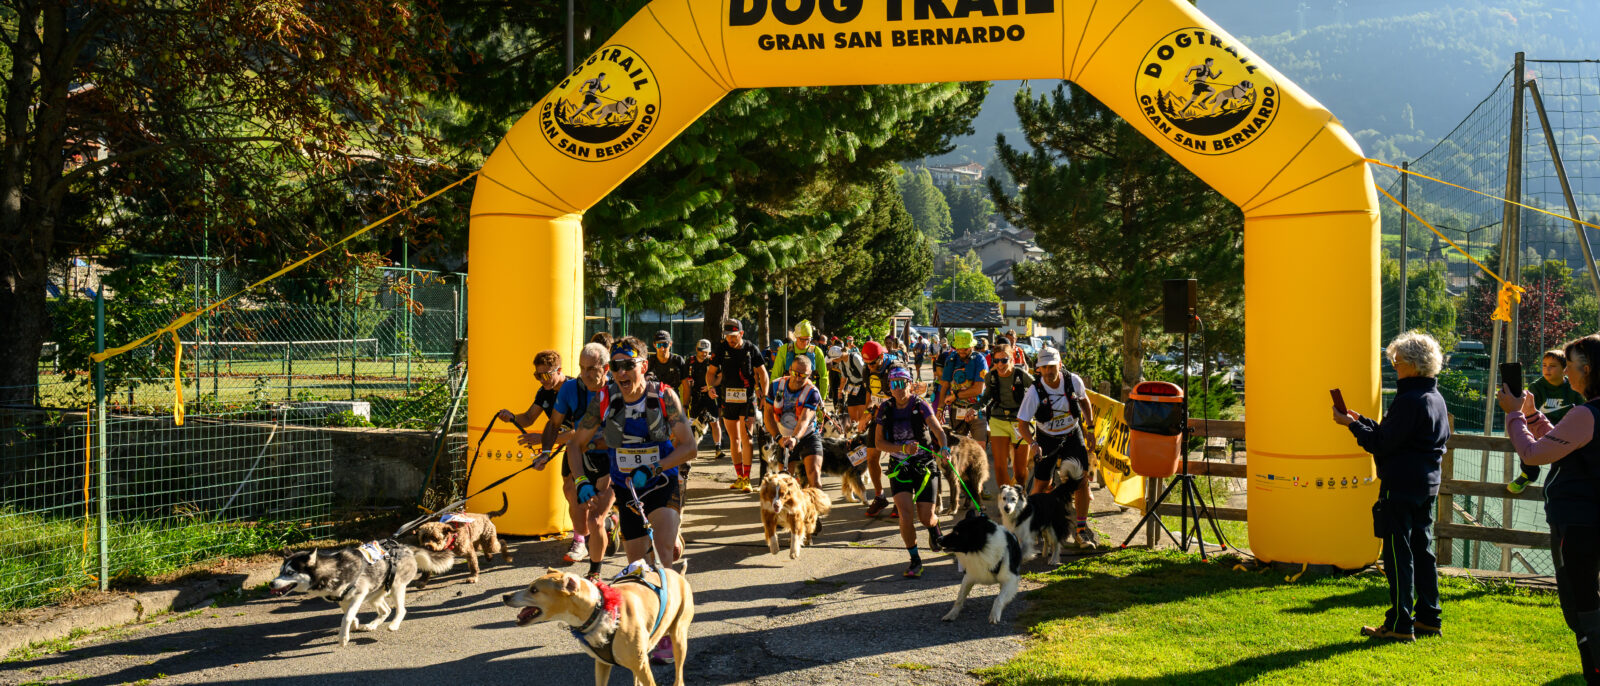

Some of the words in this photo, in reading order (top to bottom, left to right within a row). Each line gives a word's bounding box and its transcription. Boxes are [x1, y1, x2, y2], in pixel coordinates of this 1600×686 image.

[729, 0, 863, 26] DOG
[758, 33, 825, 50] GRAN
[834, 31, 882, 48] SAN
[892, 24, 1025, 47] BERNARDO
[1140, 95, 1172, 134] GRAN
[1174, 133, 1206, 151] SAN
[1212, 86, 1275, 151] BERNARDO
[542, 102, 559, 140] GRAN
[558, 138, 590, 158] SAN
[596, 103, 656, 158] BERNARDO
[732, 391, 740, 399] 42
[1545, 398, 1564, 408] NIKE
[1055, 418, 1065, 427] 22
[856, 449, 864, 458] 16
[634, 454, 642, 464] 8
